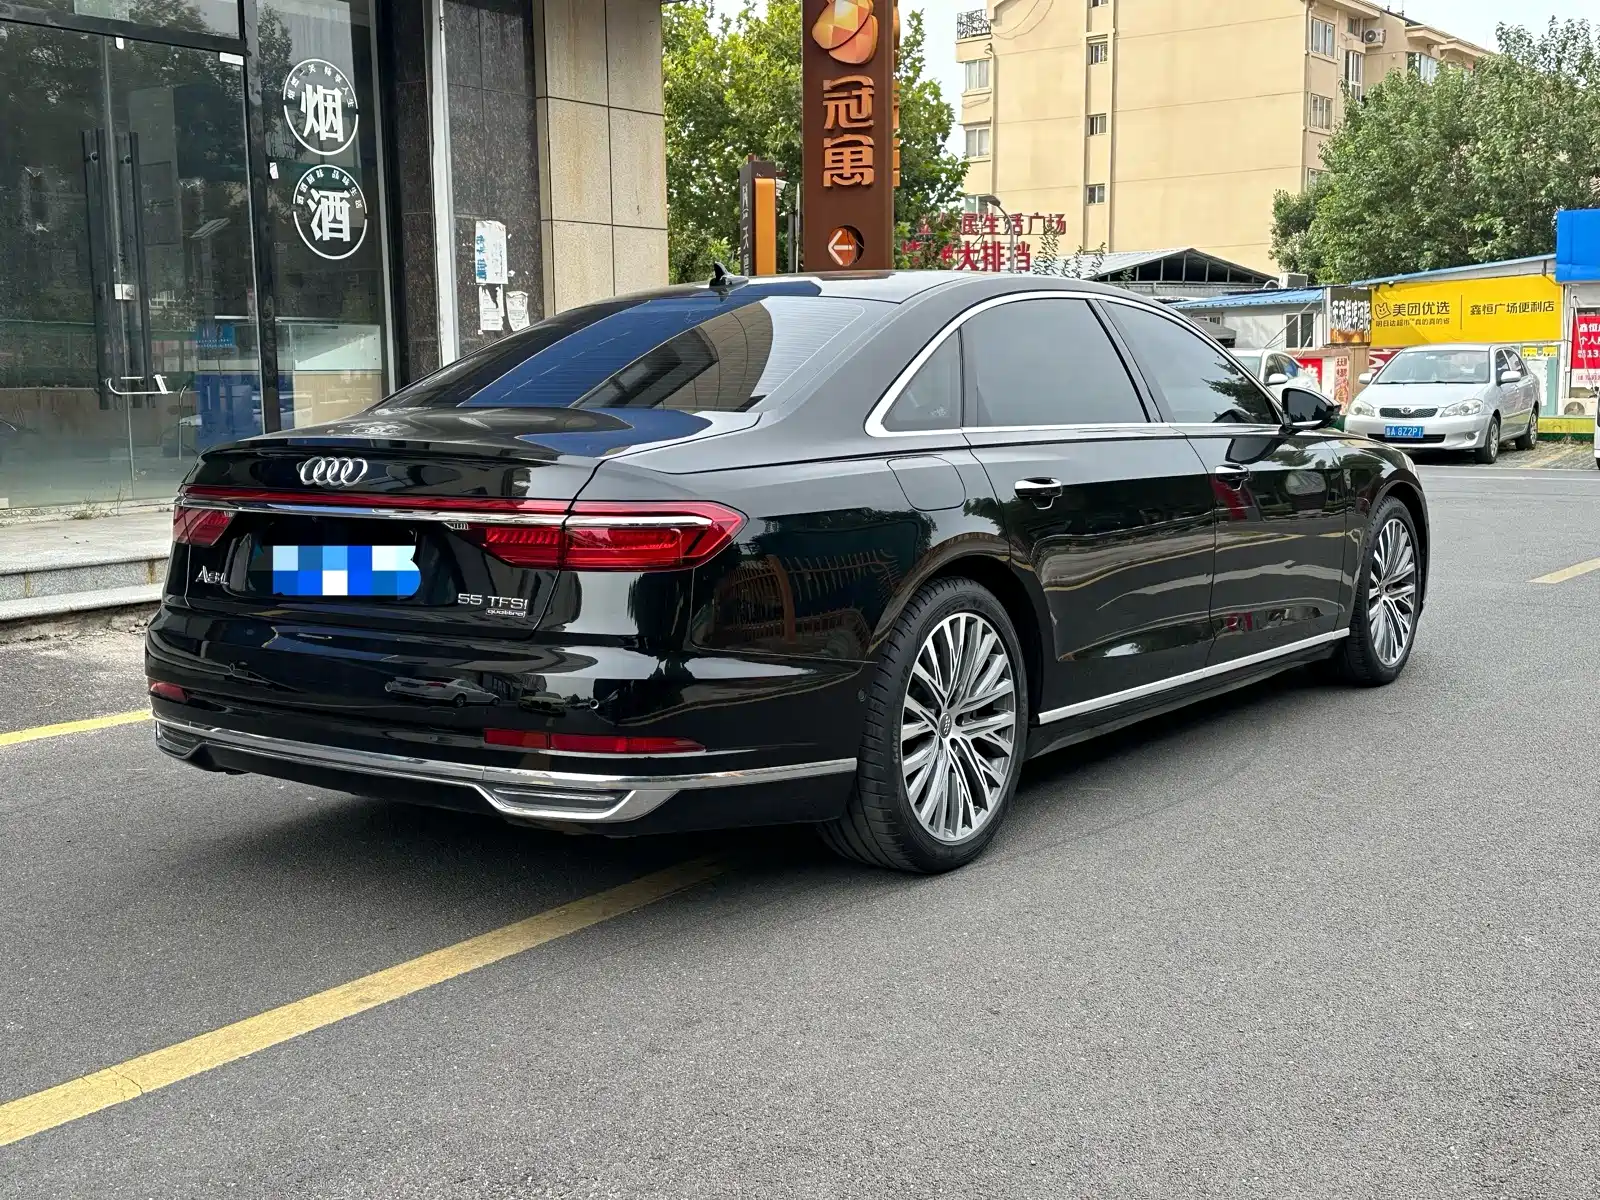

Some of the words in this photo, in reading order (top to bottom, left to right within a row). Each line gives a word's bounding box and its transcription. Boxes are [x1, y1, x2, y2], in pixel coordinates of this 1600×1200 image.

[300, 84, 344, 142] 烟
[306, 187, 351, 242] 酒
[917, 212, 1067, 236] 民生活广场
[1392, 301, 1450, 317] 美团优选
[1469, 300, 1555, 315] 鑫恒广场便利店
[1580, 323, 1600, 333] 鑫恒
[457, 593, 483, 605] 55
[487, 595, 529, 610] TFSI
